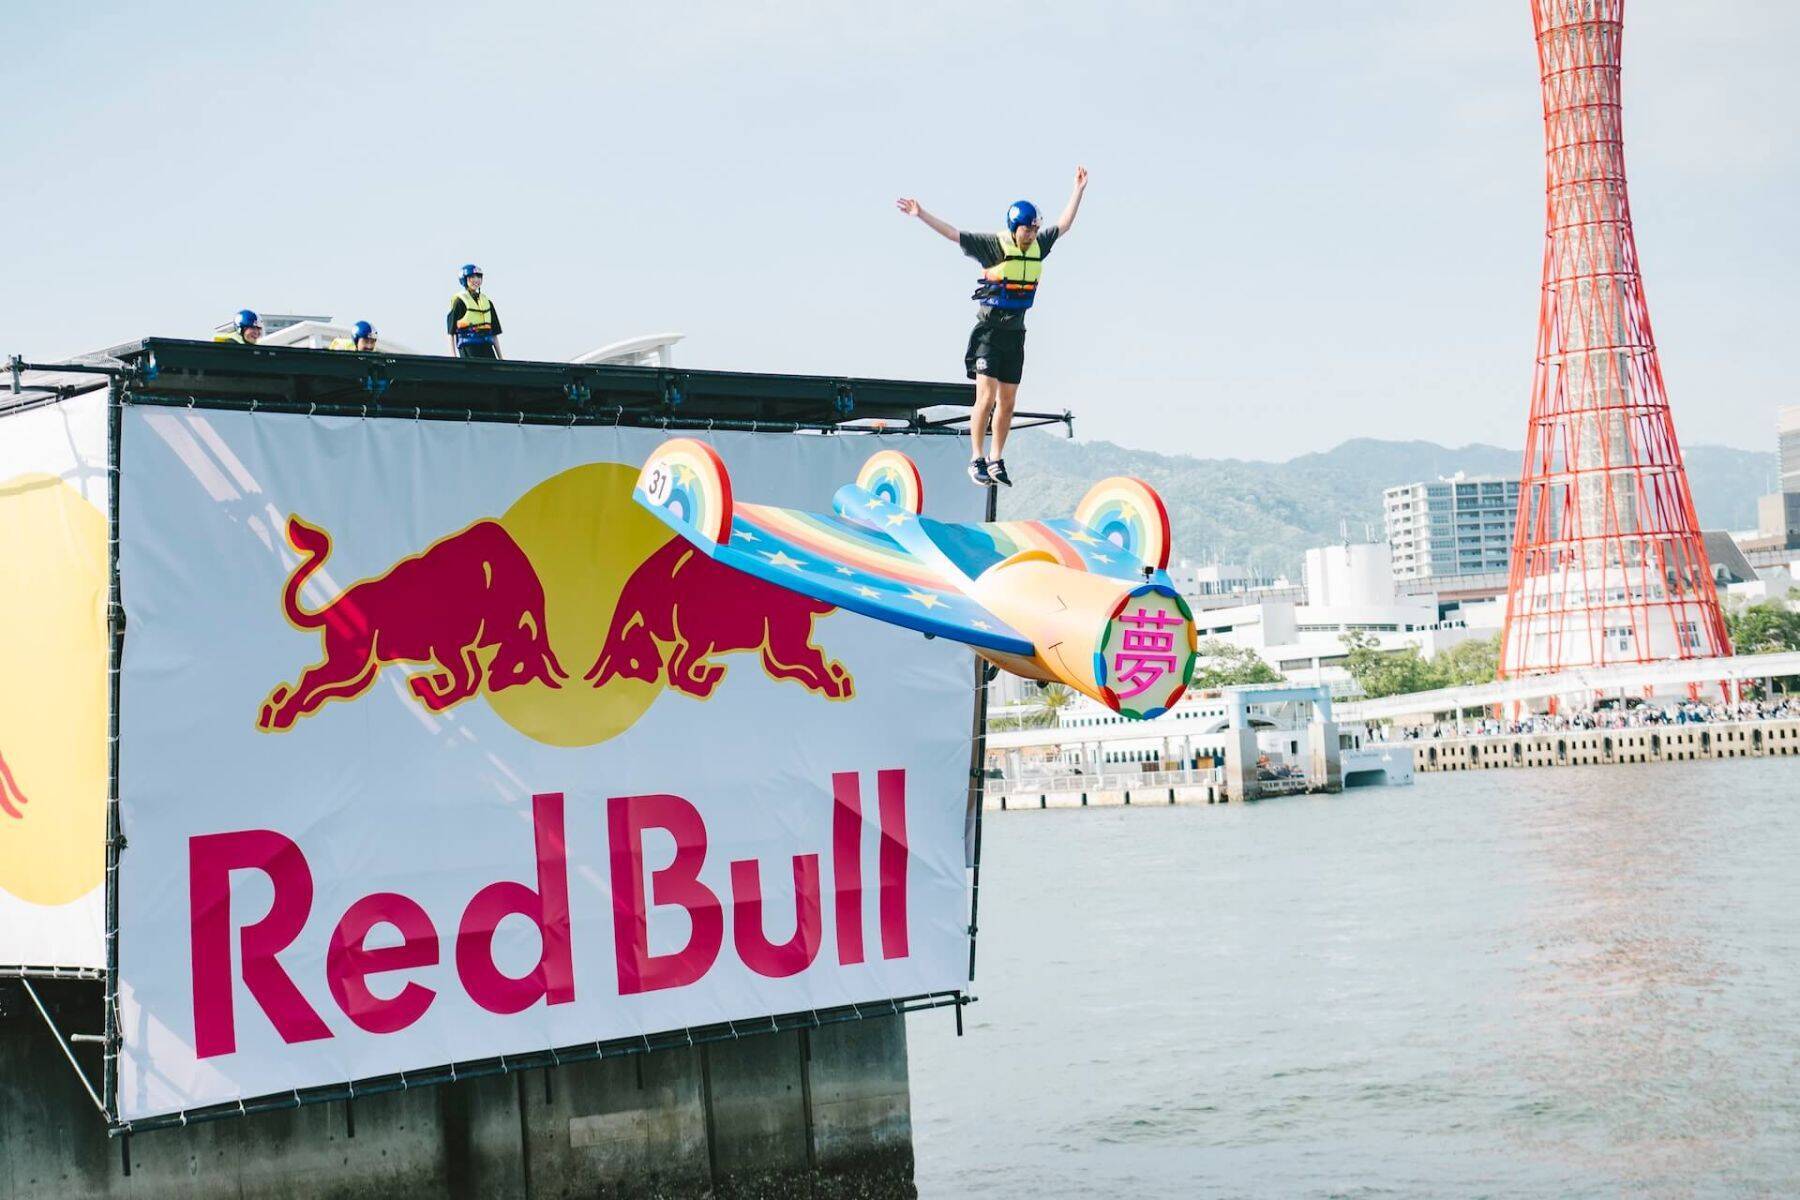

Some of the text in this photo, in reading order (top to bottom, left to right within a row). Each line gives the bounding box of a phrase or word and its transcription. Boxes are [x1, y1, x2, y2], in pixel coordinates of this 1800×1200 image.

[649, 469, 667, 500] 31
[1114, 608, 1184, 699] 夢
[189, 768, 910, 1060] Red Bull
